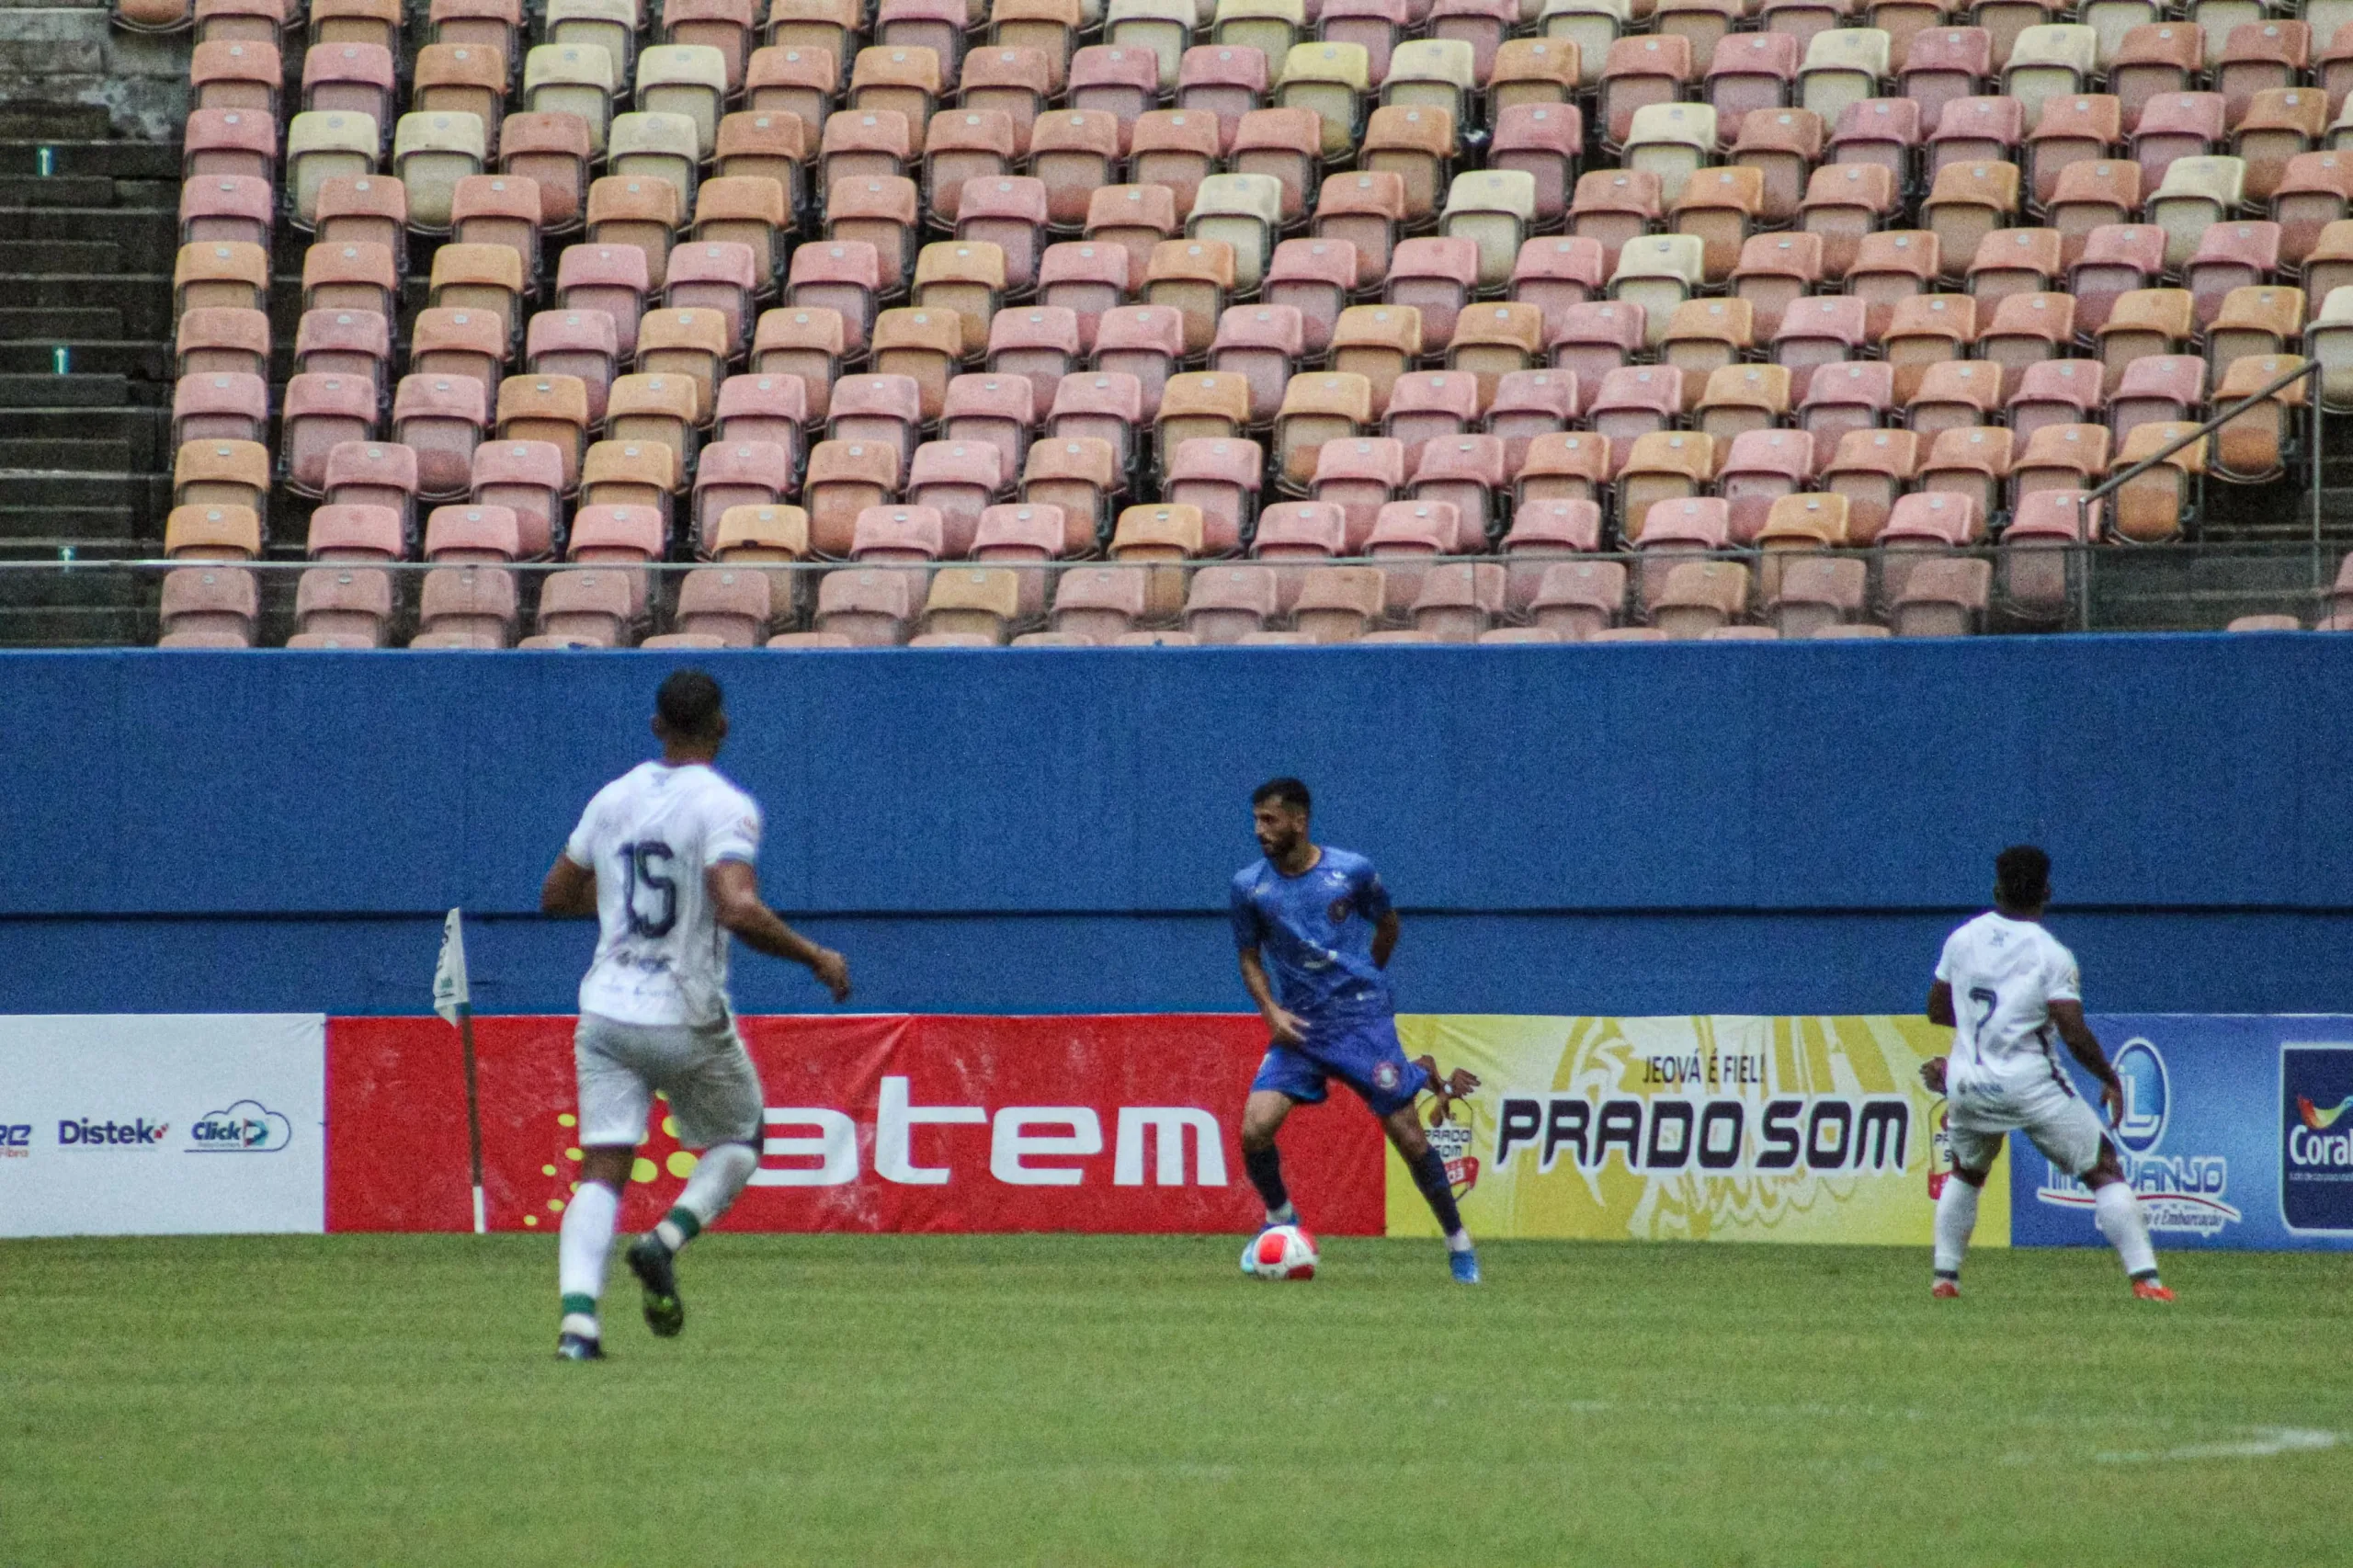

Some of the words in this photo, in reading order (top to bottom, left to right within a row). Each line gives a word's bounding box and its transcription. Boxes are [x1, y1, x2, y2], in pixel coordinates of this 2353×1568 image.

[618, 840, 676, 939] 15
[1969, 986, 1997, 1065] 7
[1643, 1048, 1700, 1083] JEOVÁ
[1708, 1048, 1718, 1083] É
[58, 1118, 155, 1145] Distek
[191, 1120, 241, 1141] Click
[1497, 1099, 1744, 1169] PRADO
[1756, 1099, 1909, 1169] SOM
